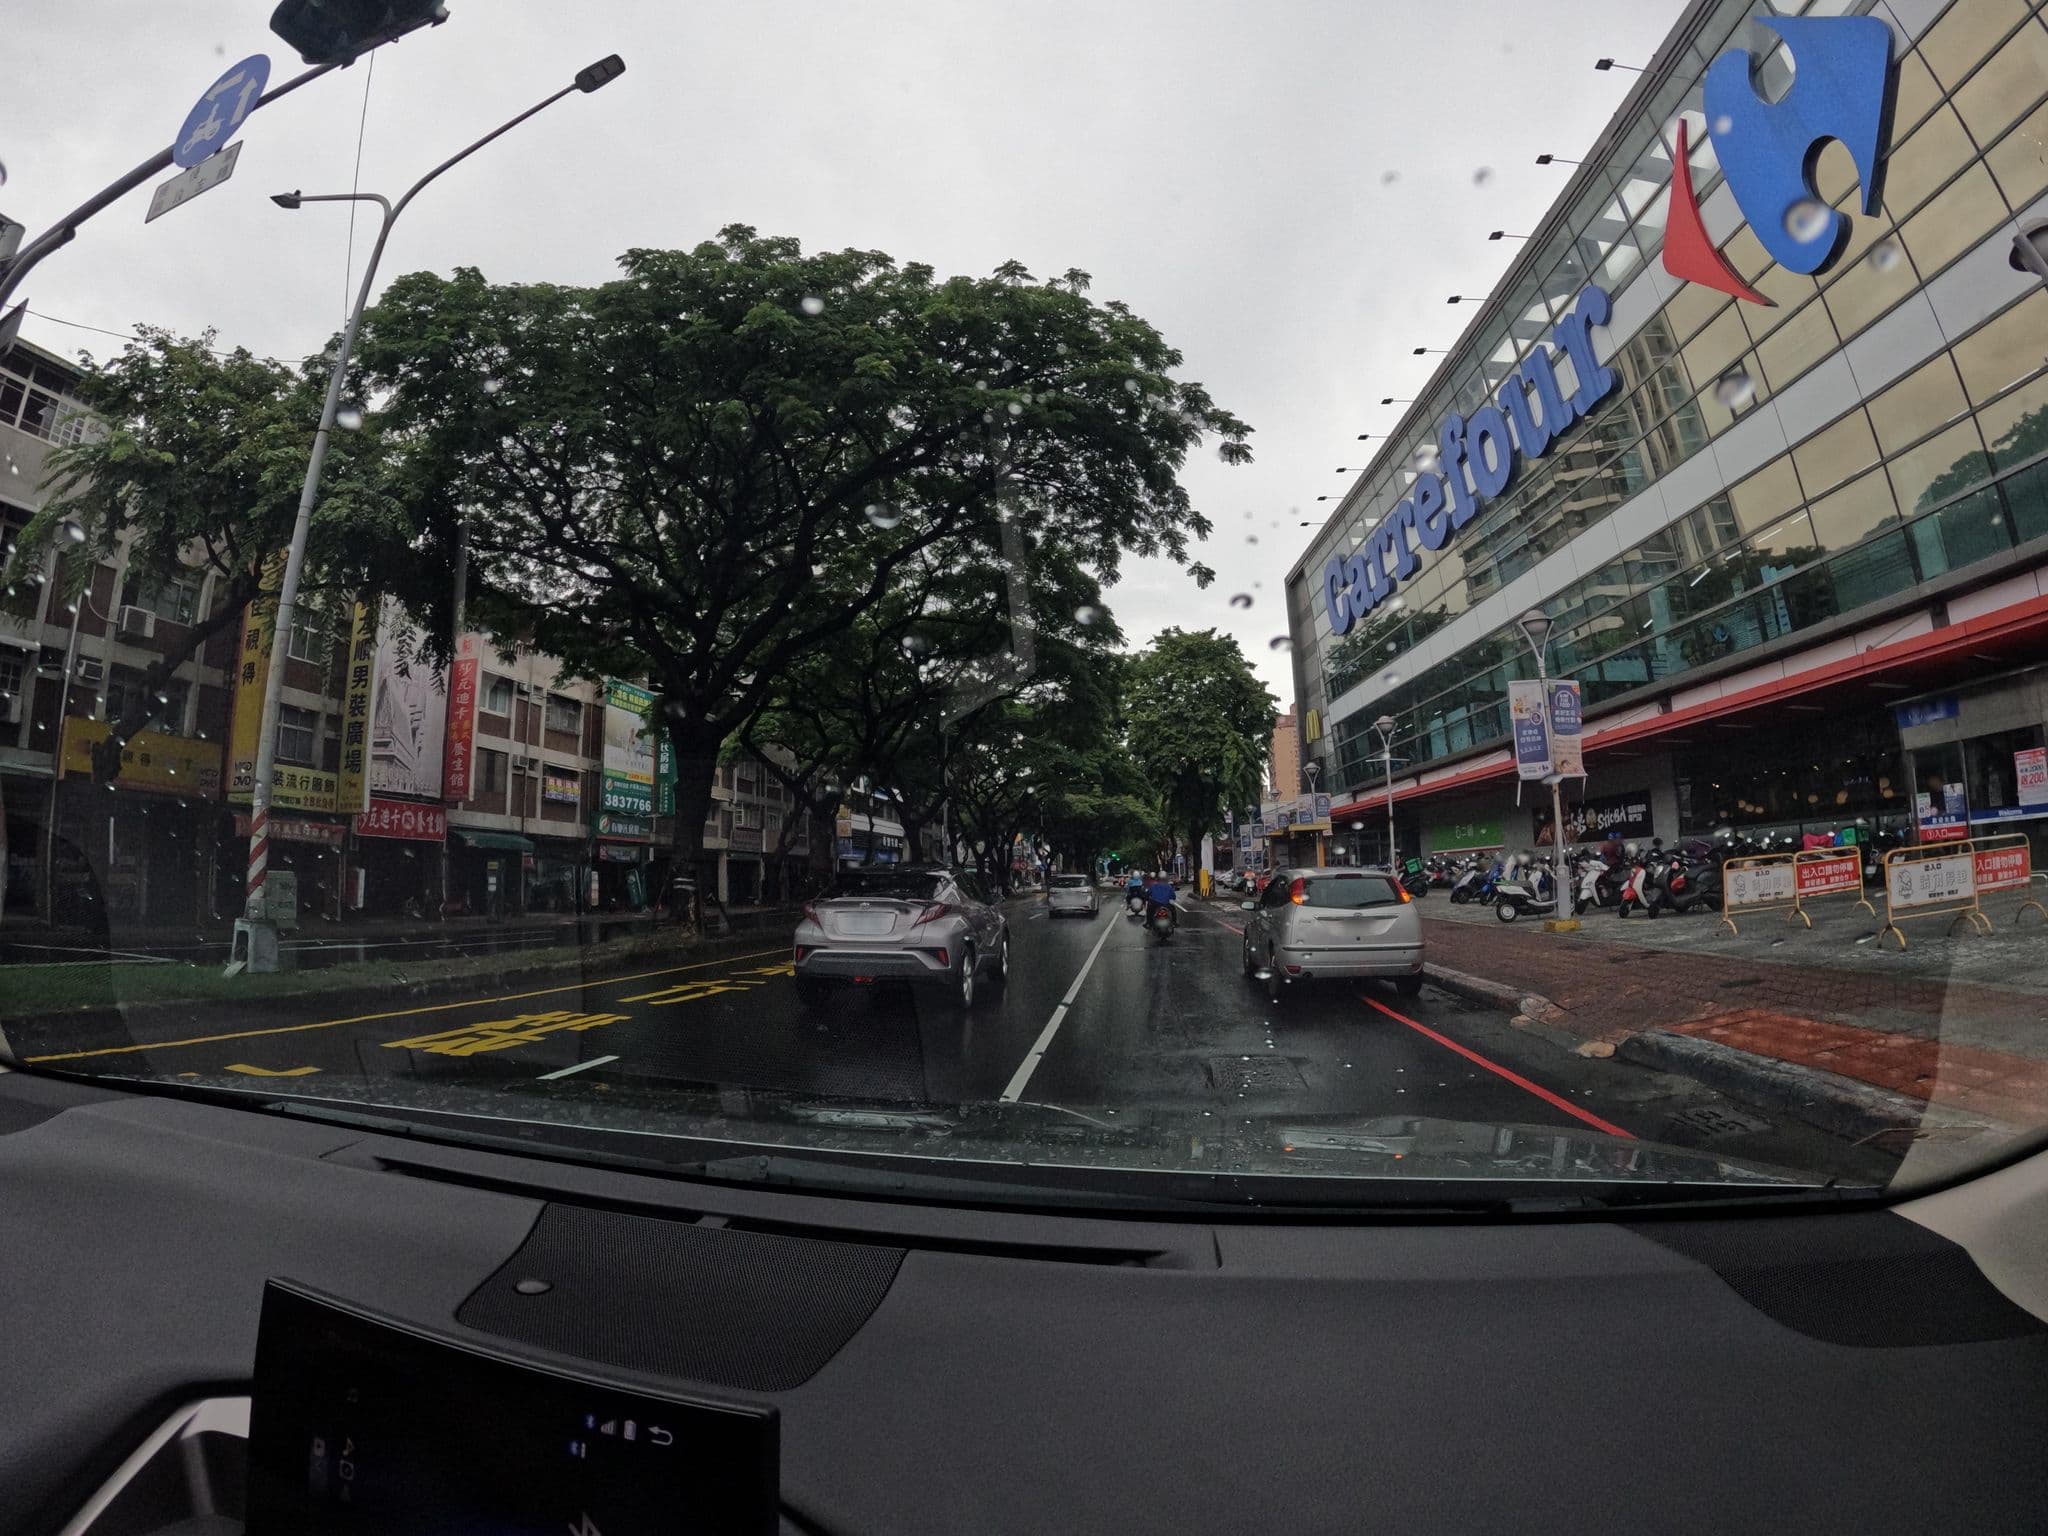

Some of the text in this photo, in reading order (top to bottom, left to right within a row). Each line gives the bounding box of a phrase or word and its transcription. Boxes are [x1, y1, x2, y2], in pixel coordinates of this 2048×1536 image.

[1323, 285, 1624, 636] Carrefour
[233, 774, 252, 787] DVD
[604, 792, 653, 813] 3837766
[1924, 862, 1942, 872] 出入口
